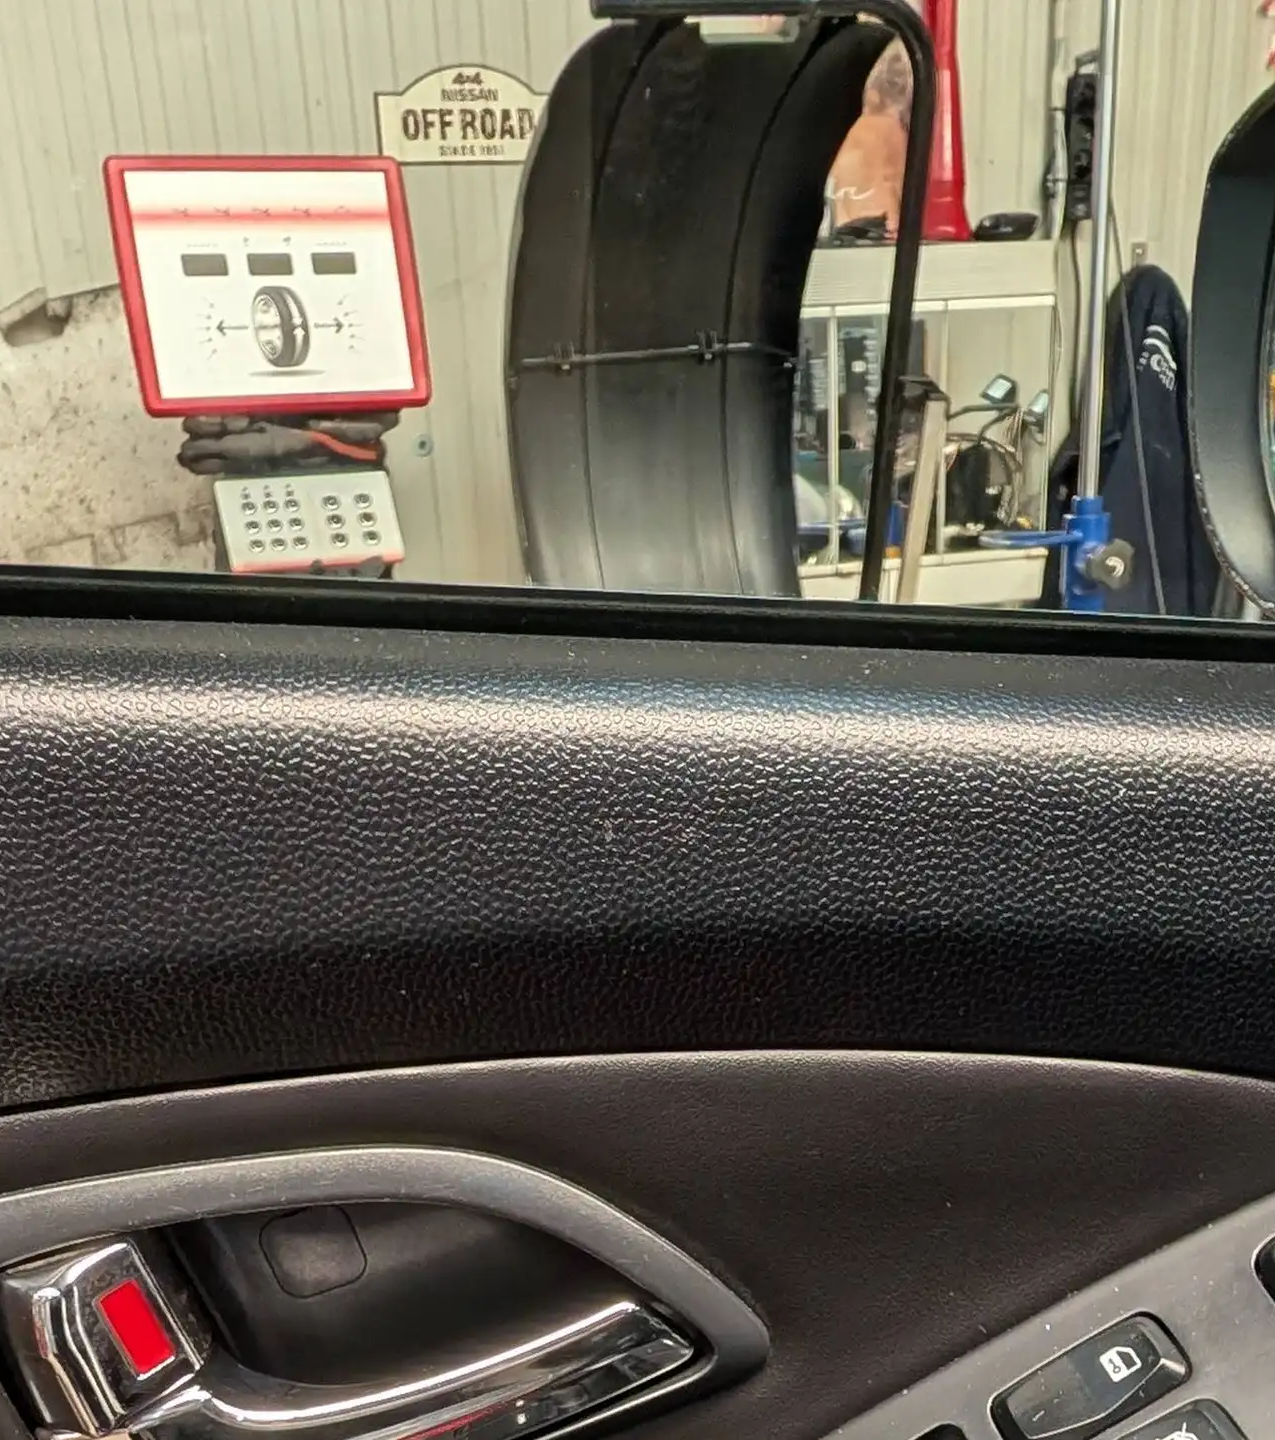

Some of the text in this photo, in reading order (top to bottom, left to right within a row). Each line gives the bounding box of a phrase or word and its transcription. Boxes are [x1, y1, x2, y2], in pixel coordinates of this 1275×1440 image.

[441, 88, 499, 102] NISSAN
[402, 107, 536, 141] OFF ROAD
